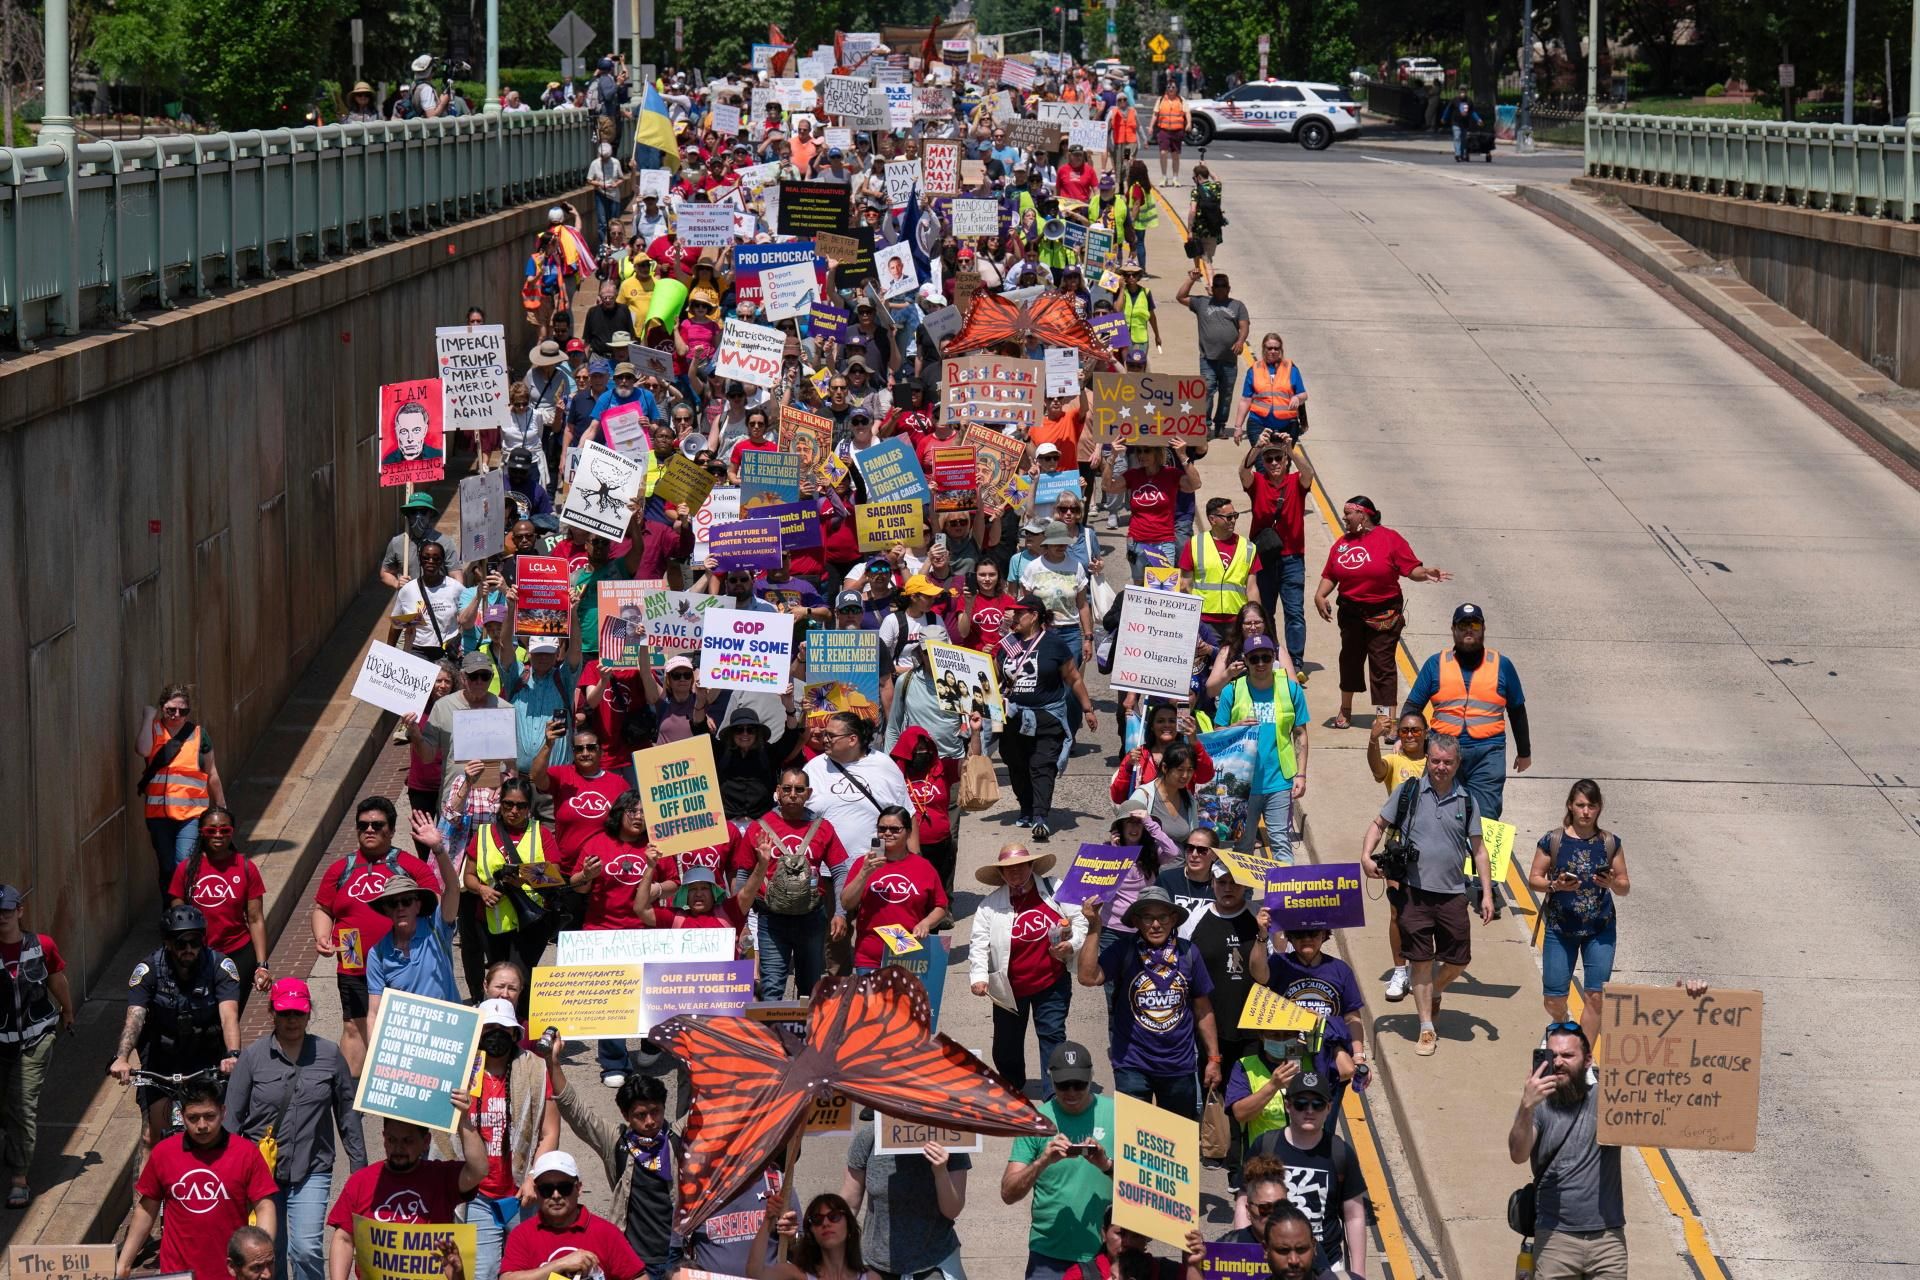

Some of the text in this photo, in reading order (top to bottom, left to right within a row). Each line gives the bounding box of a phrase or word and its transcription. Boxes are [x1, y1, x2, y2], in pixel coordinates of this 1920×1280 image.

[824, 76, 869, 95] VETERANS
[921, 88, 943, 96] MAKE
[826, 90, 865, 104] AGAINST
[916, 95, 946, 103] AMERICA
[921, 101, 943, 109] THINK
[827, 100, 866, 115] FASCISM
[1042, 104, 1084, 120] TAX
[1243, 111, 1298, 119] POLICE
[1008, 132, 1052, 144] AMERICA
[1015, 126, 1043, 136] MAKE
[928, 146, 954, 157] MAY
[927, 158, 957, 170] DAY!
[925, 171, 952, 181] MAY
[926, 181, 955, 192] DAY!
[955, 199, 999, 213] HANDS OFF
[954, 212, 999, 224] My Patients
[956, 223, 999, 234] HEALTHCARE
[738, 253, 759, 265] PRO
[767, 270, 792, 281] Deport
[768, 278, 806, 290] Obnoxious
[770, 290, 797, 300] Grifting
[441, 335, 501, 353] IMPEACH
[449, 353, 498, 367] TRUMP
[720, 348, 780, 378] WWJD?
[451, 369, 490, 382] MAKE
[947, 362, 990, 383] Resist
[992, 362, 1039, 383] Fascism!
[394, 385, 428, 403] I AM
[445, 381, 499, 395] AMERICA
[949, 386, 977, 401] Fight
[1096, 377, 1207, 406] We Say NO
[459, 393, 494, 406] KIND
[453, 406, 494, 419] AGAIN
[783, 406, 833, 431] FREE KILMAR
[947, 406, 1017, 420] Due For
[1096, 407, 1208, 442] Project 2025
[970, 424, 1025, 453] FREE KILMAR
[382, 457, 442, 475] STEALING
[589, 443, 640, 472] IMMIGRANT ROOTS
[856, 448, 904, 472] FAMILIES
[389, 467, 438, 484] FROM YOU.
[868, 464, 901, 486] BELONG
[873, 472, 919, 497] TOGETHER.
[1132, 488, 1166, 502] CASA
[866, 503, 914, 519] SACAMOS
[566, 510, 622, 536] IMMIGRANT RIGHTS
[878, 517, 906, 530] A USA
[867, 529, 917, 543] ADELANTE
[1337, 551, 1372, 564] CASA
[528, 563, 558, 572] LCLAA
[643, 590, 668, 608] MAY
[1127, 594, 1198, 612] WE the PEOPLE
[645, 602, 675, 620] DAY!
[1144, 607, 1177, 620] Declare
[654, 621, 687, 637] SAVE
[732, 620, 765, 635] GOP
[1127, 622, 1184, 640] NO Tyrants
[703, 635, 789, 655] SHOW SOME
[809, 633, 877, 647] WE HONOR AND
[719, 653, 770, 669] MORAL
[809, 648, 877, 663] WE REMEMBER
[933, 647, 961, 661] ABDUCTED
[1123, 646, 1189, 666] NO Oligarchs
[366, 654, 384, 673] We
[394, 666, 431, 693] People
[809, 663, 877, 673] THE KEY BRIDGE FAMILIES
[935, 658, 972, 674] DISAPPEARED
[711, 667, 779, 685] COURAGE
[1119, 671, 1178, 689] NO KINGS!
[368, 676, 383, 686] have
[393, 686, 417, 700] enough
[661, 760, 691, 780] STOP
[650, 775, 709, 803] PROFITING
[659, 794, 707, 819] OFF OUR
[653, 815, 720, 841] SUFFERING.
[871, 880, 920, 896] CASA
[1267, 876, 1359, 895] Immigrants Are
[1283, 894, 1341, 910] Essential
[391, 999, 459, 1026] WE REFUSE TO
[1604, 994, 1753, 1037] They fear
[387, 1014, 431, 1032] LIVE IN A
[383, 1027, 465, 1054] COUNTRY WHERE
[377, 1052, 413, 1070] CAN BE
[380, 1041, 457, 1066] OUR NEIGHBORS
[1604, 1033, 1752, 1073] LOVE because
[373, 1065, 453, 1093] DISAPPEARED IN
[1604, 1069, 1713, 1087] it a
[370, 1077, 433, 1102] THE DEAD OF
[1653, 1088, 1682, 1106] they
[367, 1094, 399, 1110] NIGHT.
[892, 1126, 962, 1144] RIGHTS
[1136, 1130, 1176, 1158] CESSEZ
[1123, 1144, 1190, 1182] DE PROFITER
[171, 1181, 231, 1201] CASA
[1138, 1168, 1177, 1197] DE NOS
[1118, 1181, 1195, 1224] SOUFFRANCES.
[370, 1227, 399, 1249] WE
[19, 1254, 92, 1274] The Bill
